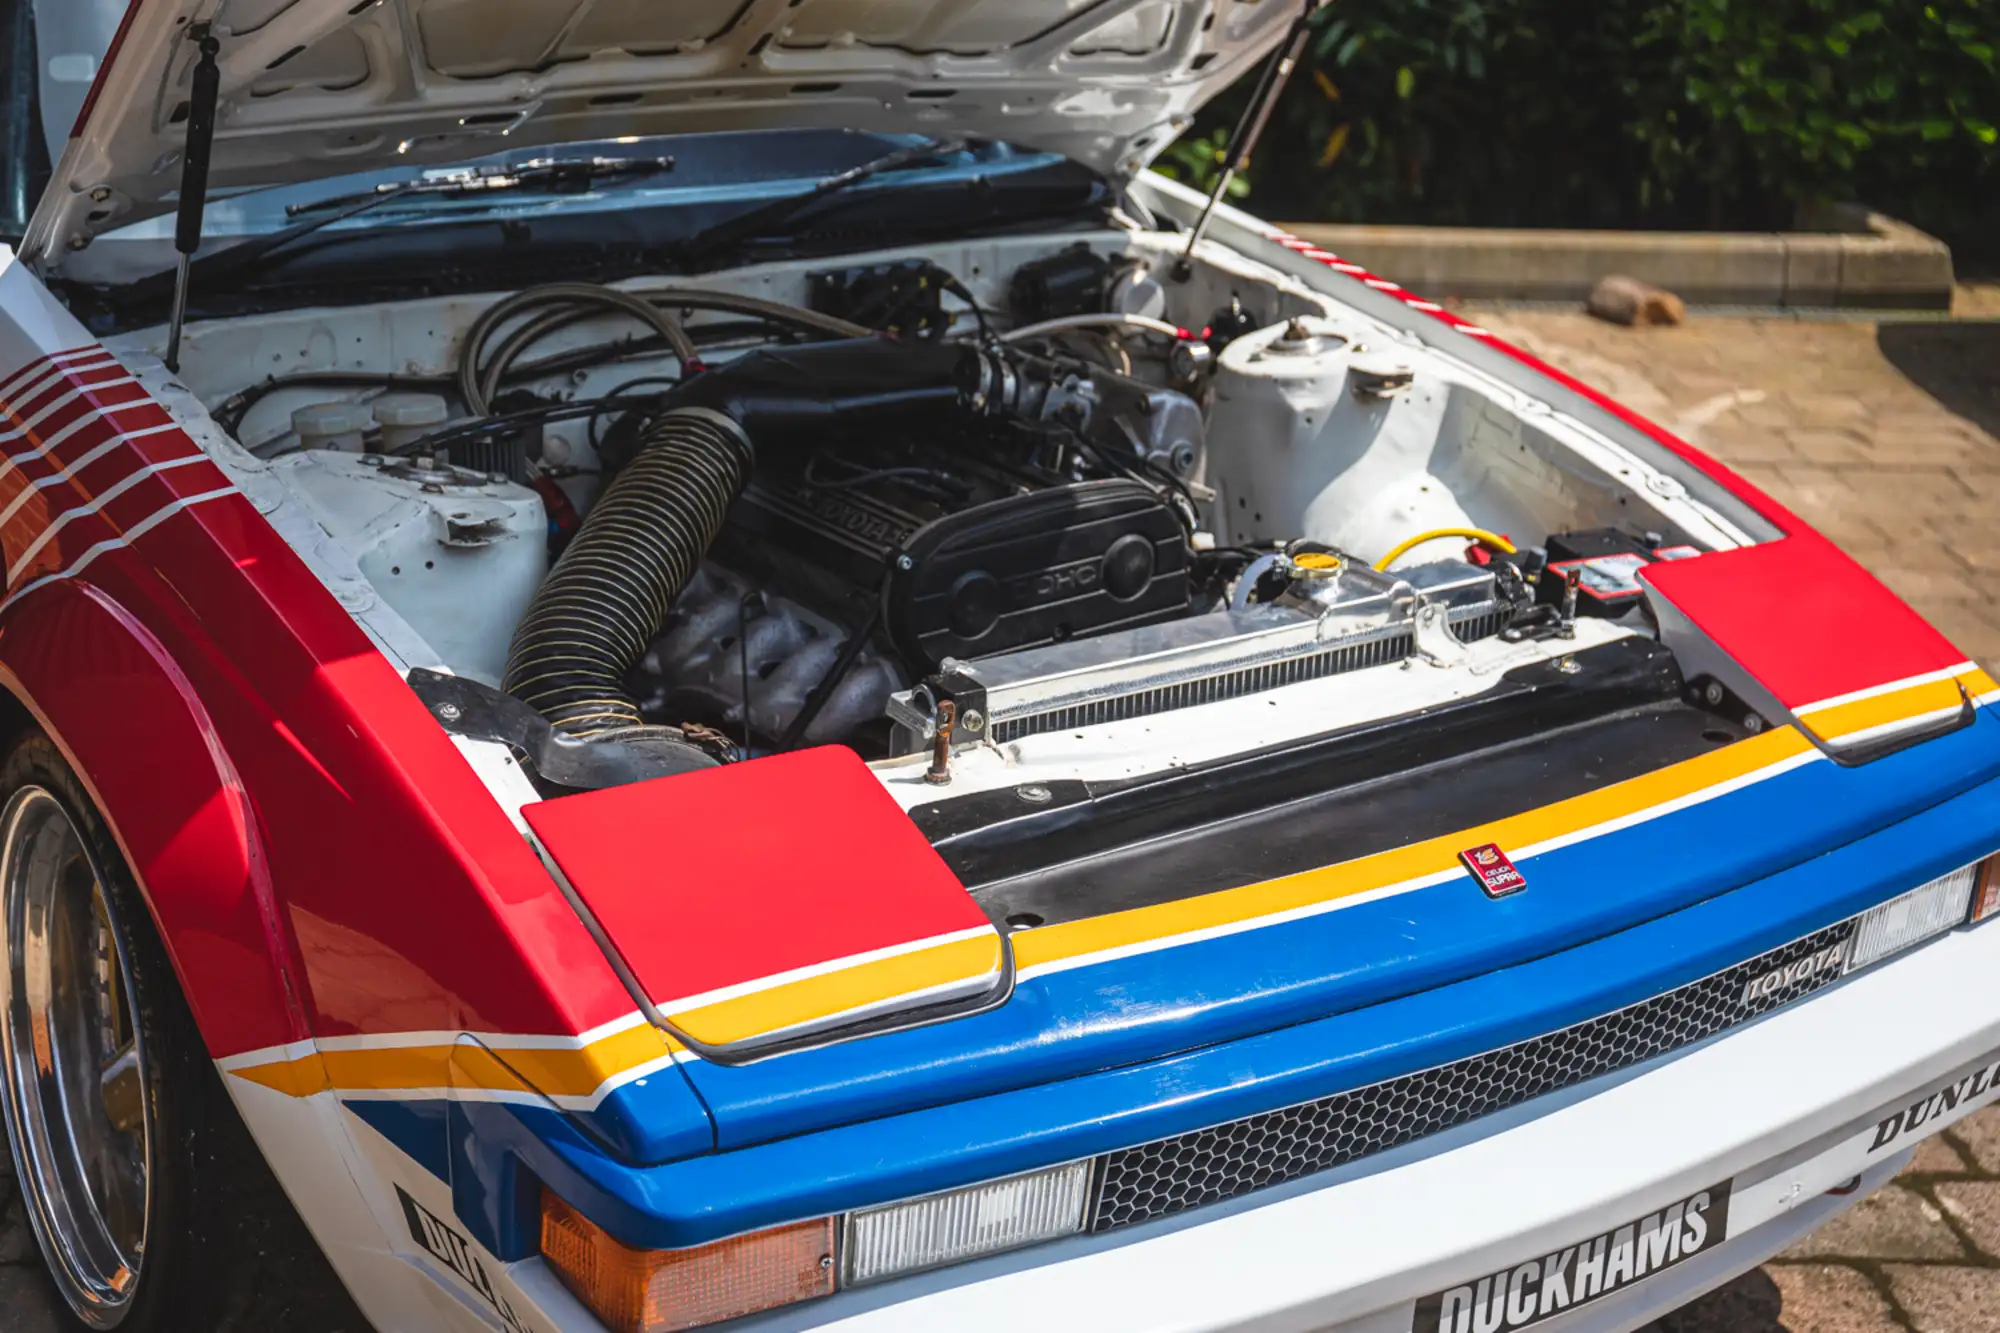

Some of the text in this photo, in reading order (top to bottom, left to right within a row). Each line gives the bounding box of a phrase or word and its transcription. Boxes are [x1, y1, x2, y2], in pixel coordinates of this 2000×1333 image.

[1486, 871, 1520, 887] SUPRA
[1748, 943, 1841, 1001] TOYOTA
[1438, 1191, 1711, 1333] DUCKHAMS
